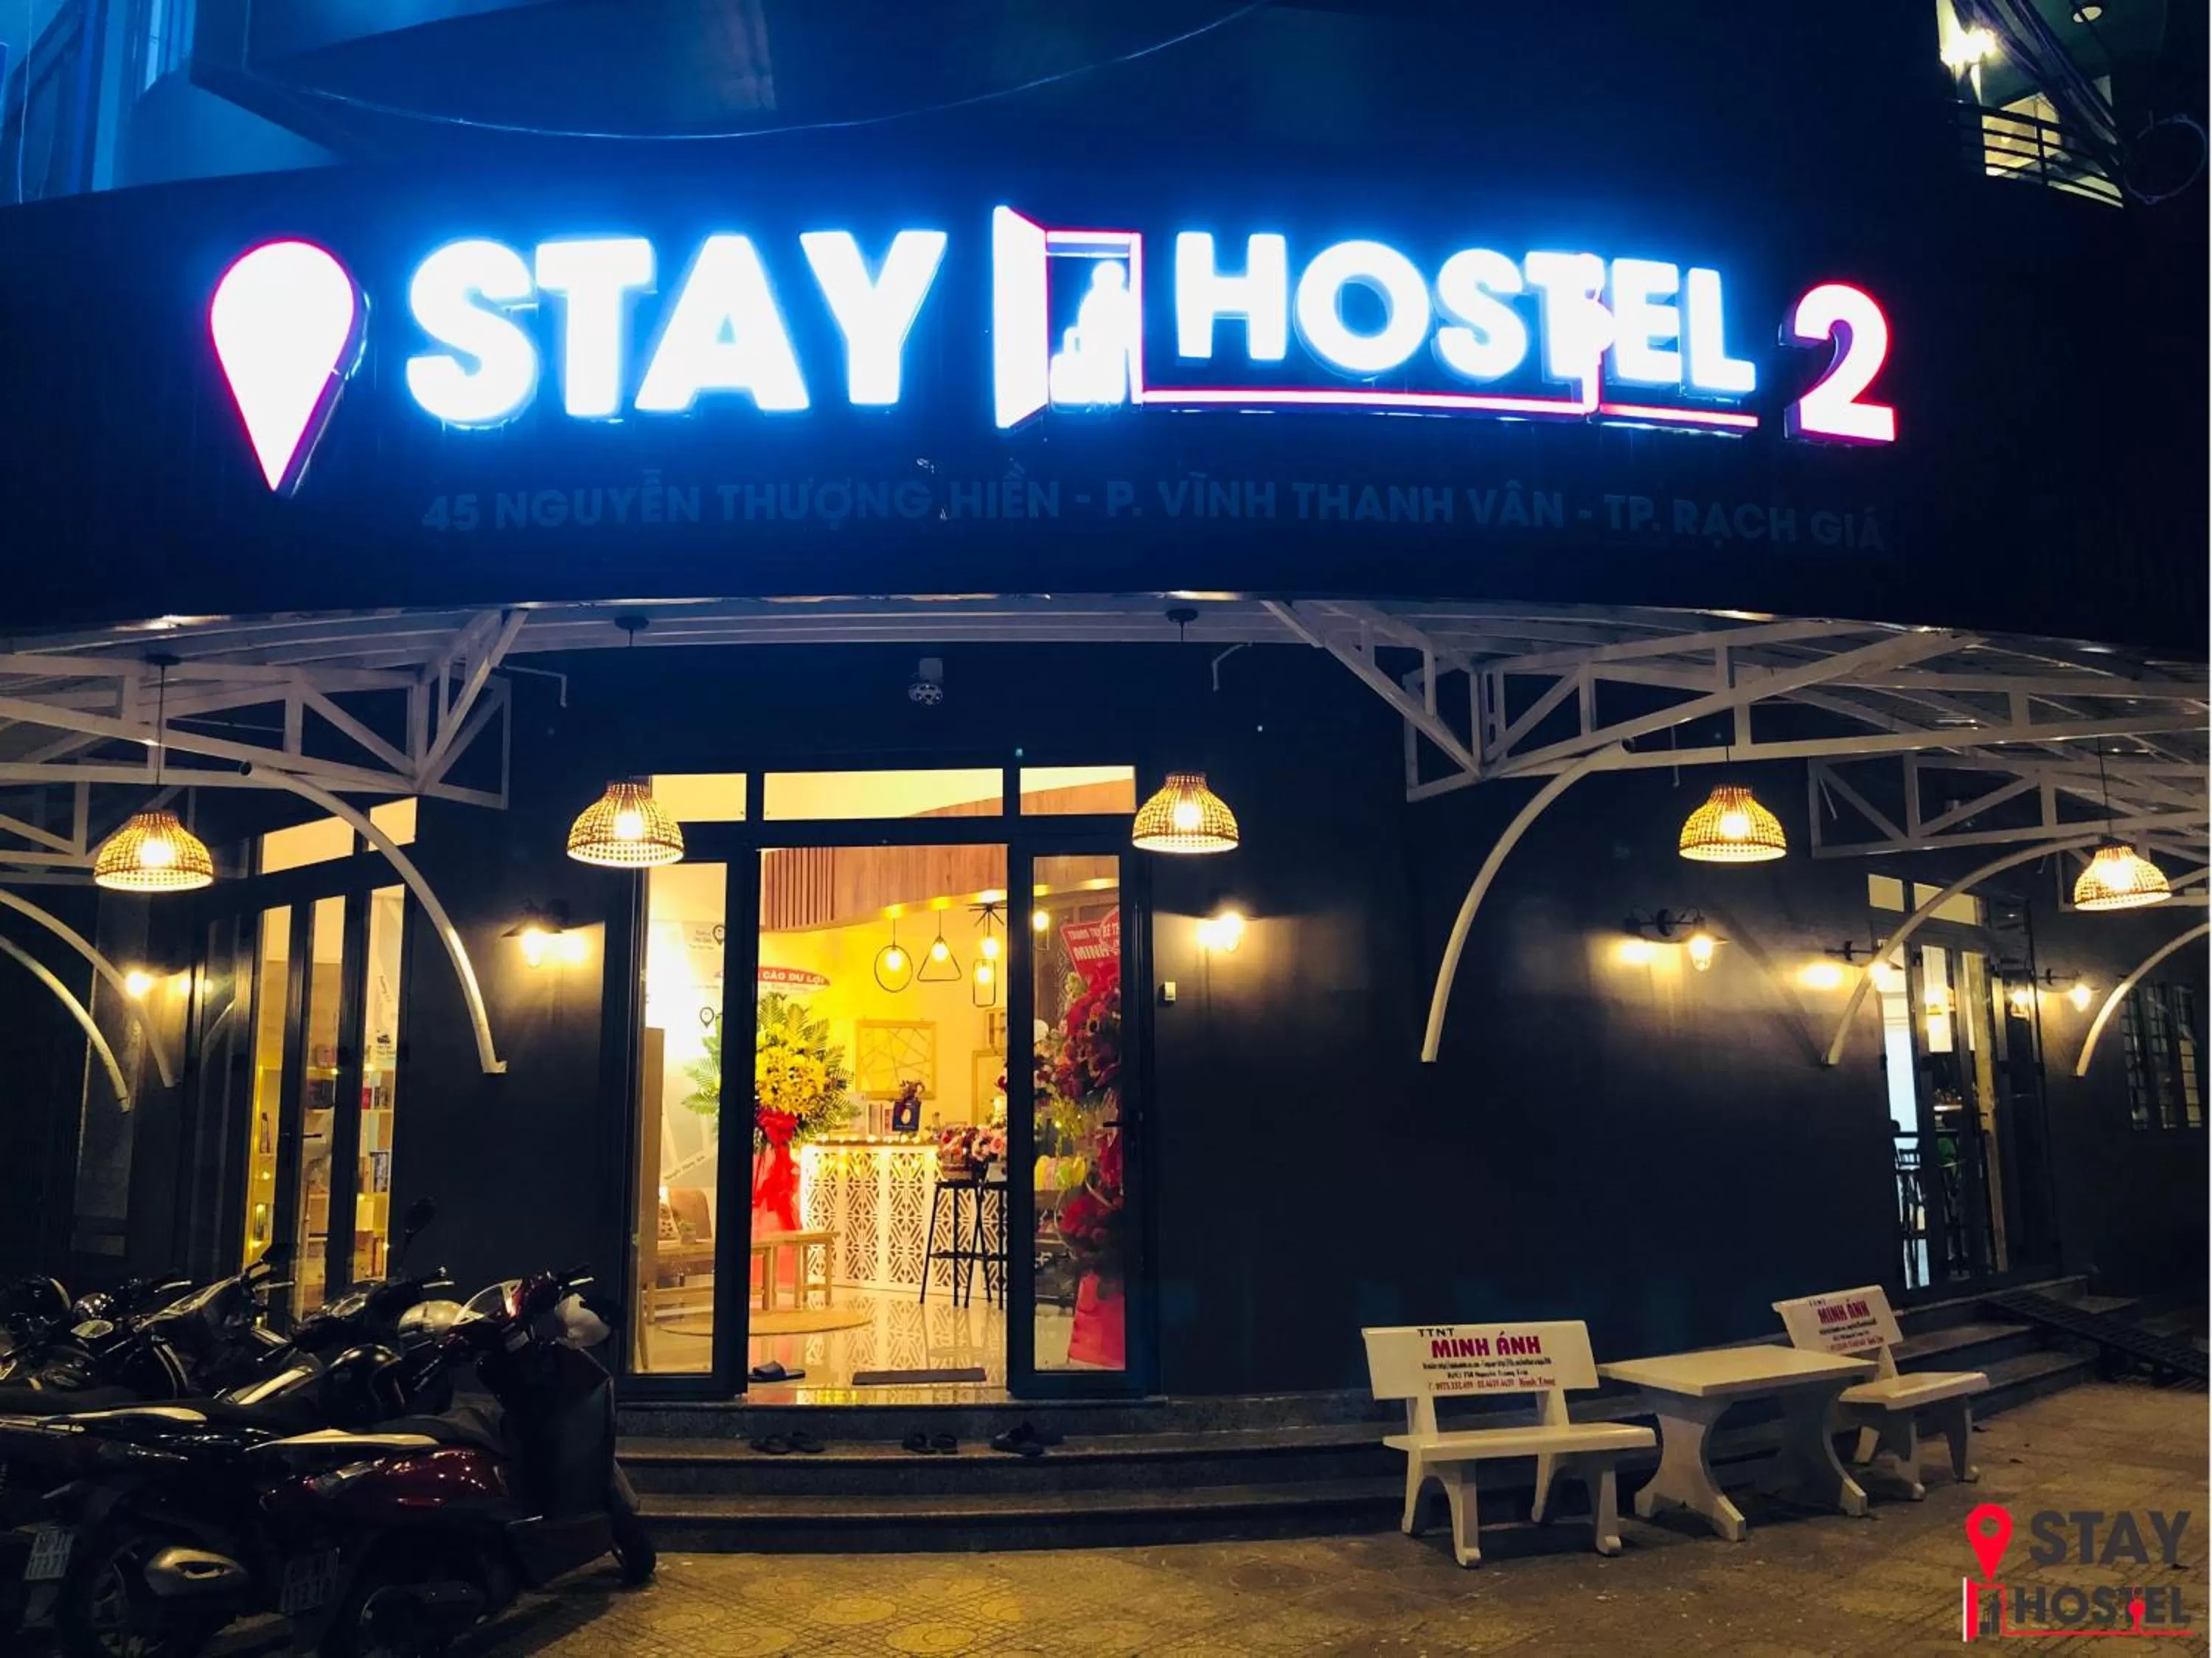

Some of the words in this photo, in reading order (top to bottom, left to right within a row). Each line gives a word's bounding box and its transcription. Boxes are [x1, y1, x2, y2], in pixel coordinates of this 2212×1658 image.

[405, 230, 948, 426] STAY
[1175, 230, 1758, 394] HOSTEL
[1786, 283, 1896, 444] 2
[422, 493, 479, 533] 45
[495, 468, 700, 528] NGUYỄN
[717, 478, 933, 532] THƯỢNG
[948, 457, 1060, 520] HIỀN
[1106, 480, 1142, 518] P.
[1156, 471, 1276, 519] VĨNH
[1291, 482, 1453, 524] THANH
[1465, 479, 1565, 527] VÂN
[1603, 493, 1661, 533] TP.
[1672, 498, 1798, 549] RẠCH
[1810, 506, 1885, 552] GIÁ
[1416, 1327, 1455, 1337] TTNT
[1431, 1337, 1490, 1359] MINH
[1495, 1331, 1542, 1356] ÁNH
